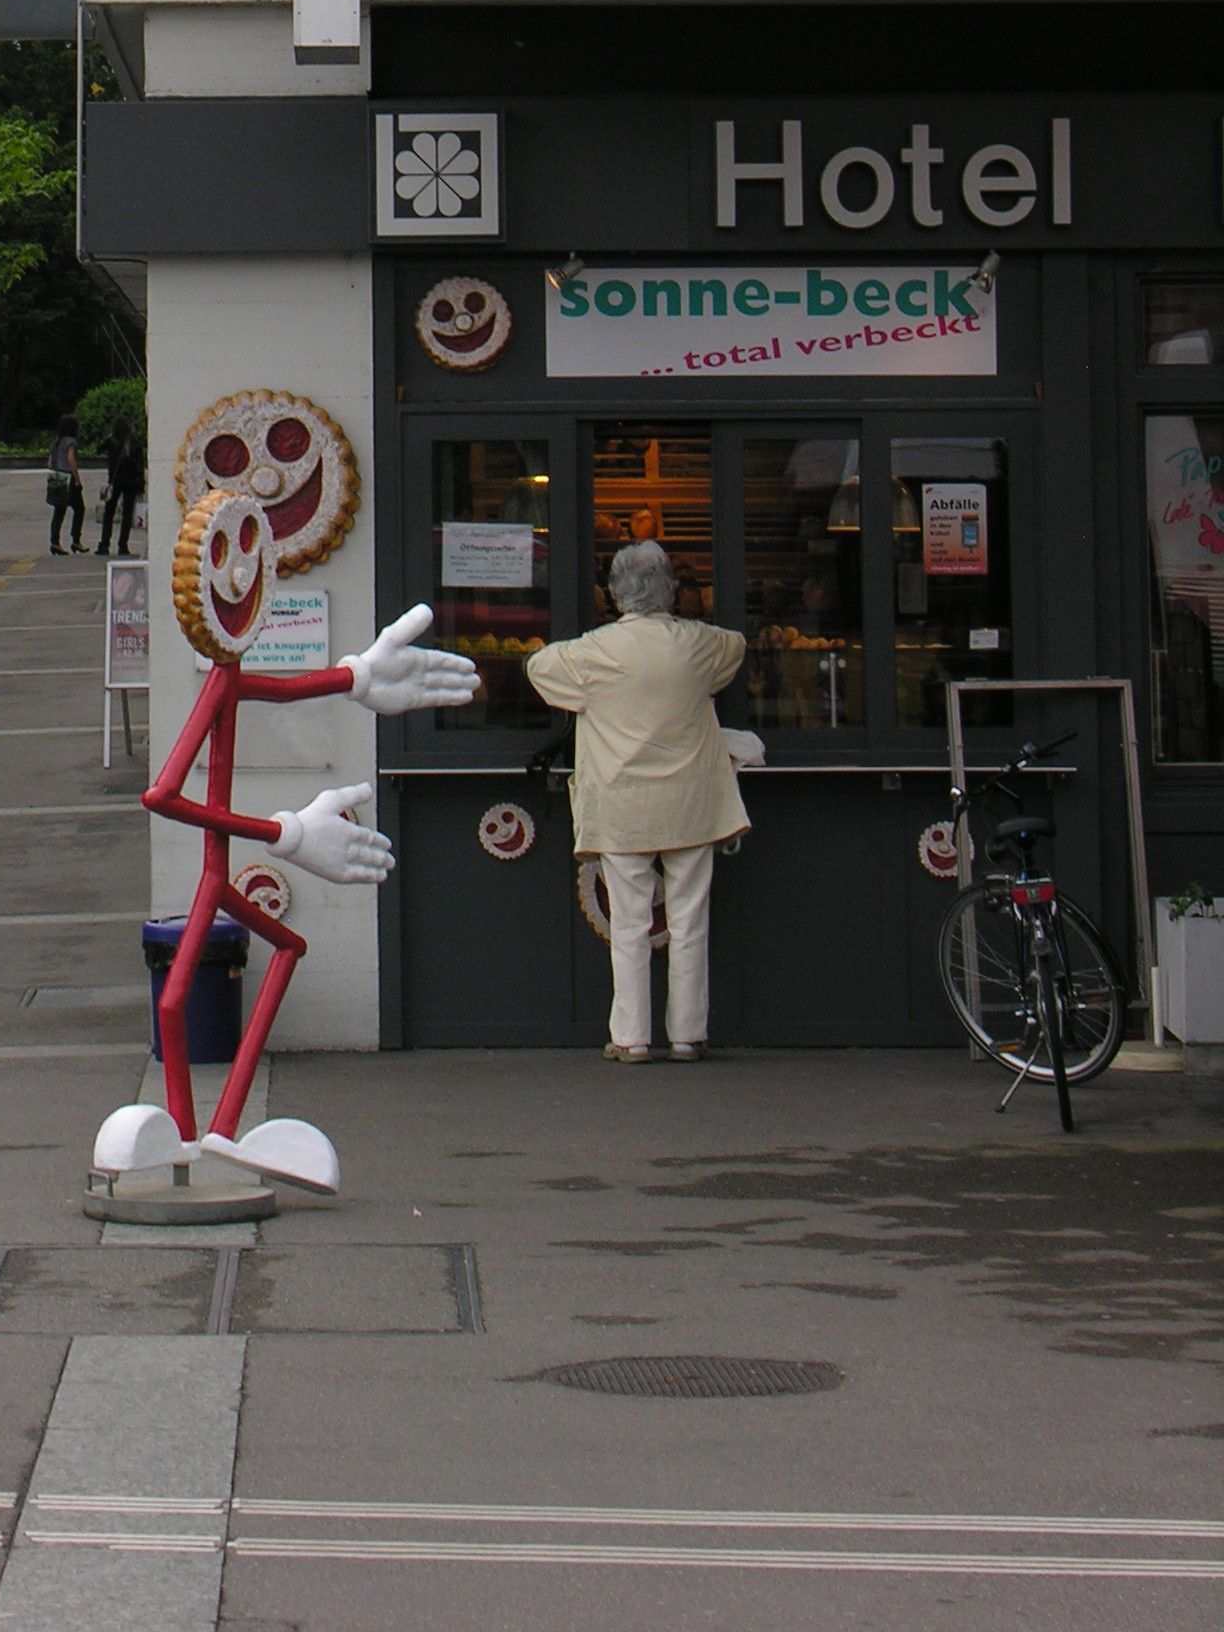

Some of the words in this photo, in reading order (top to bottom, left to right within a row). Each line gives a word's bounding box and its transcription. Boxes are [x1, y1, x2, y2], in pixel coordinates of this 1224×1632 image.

[715, 117, 1072, 229] Hotel
[559, 270, 979, 318] sonne-beck
[683, 337, 782, 370] total
[795, 314, 981, 356] verbeckt
[930, 498, 980, 510] Abfälle
